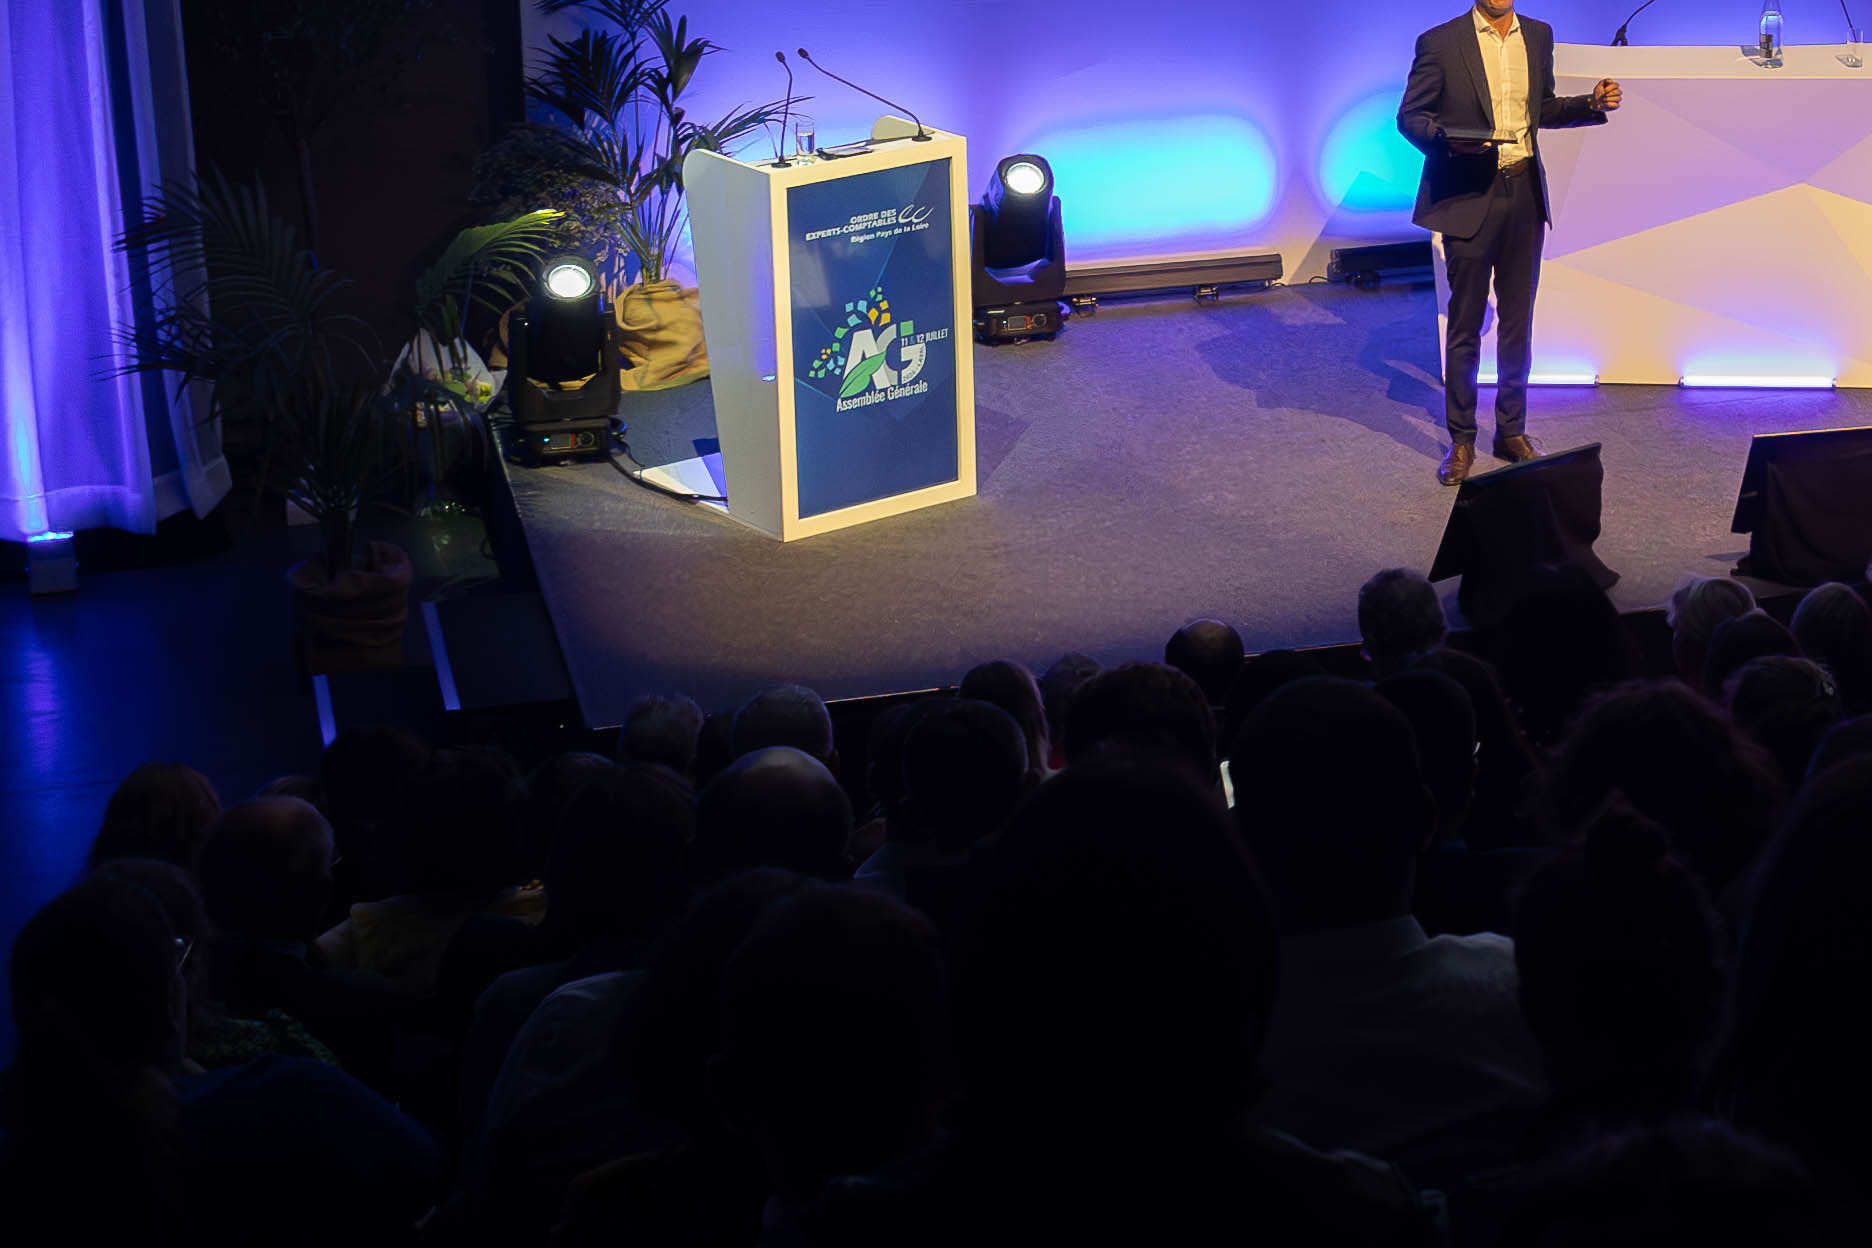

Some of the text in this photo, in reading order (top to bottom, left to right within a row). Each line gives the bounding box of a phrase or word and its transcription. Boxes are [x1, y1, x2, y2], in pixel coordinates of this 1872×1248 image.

[850, 208, 897, 224] ORDRE DES
[805, 216, 897, 241] EXPERTS-COMPTABLES
[901, 337, 909, 347] 11
[917, 333, 925, 343] 12
[925, 328, 949, 343] JUILLET
[836, 379, 928, 413] Assemblée Générale
